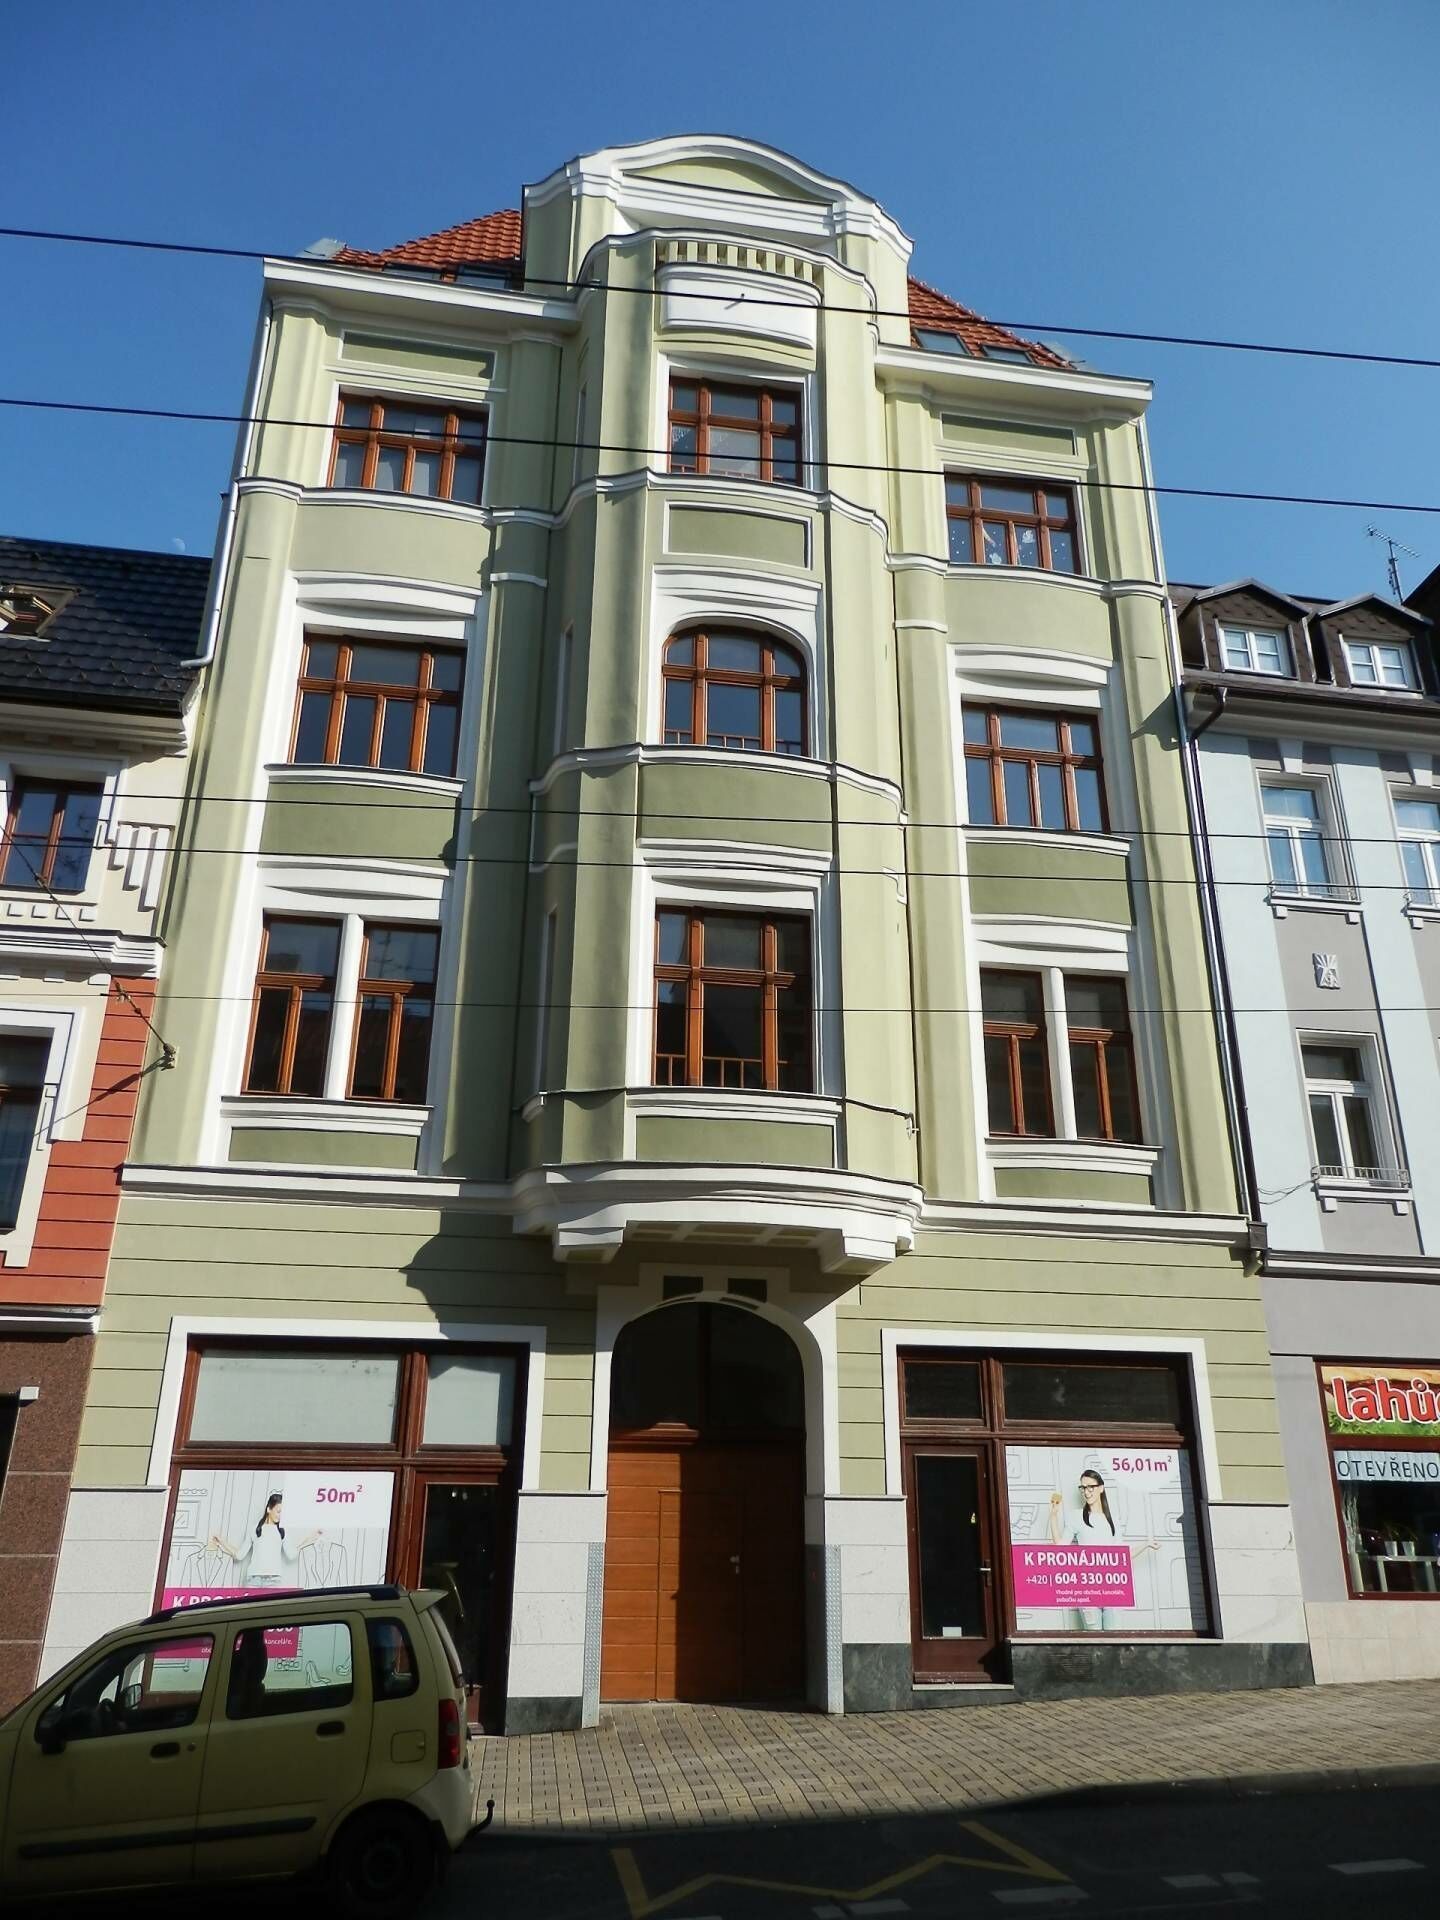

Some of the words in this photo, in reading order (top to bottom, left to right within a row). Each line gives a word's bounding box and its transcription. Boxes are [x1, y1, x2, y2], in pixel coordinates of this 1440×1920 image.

[1332, 1376, 1440, 1423] lahů
[1337, 1457, 1439, 1479] OTEVŘENO
[1024, 1552, 1035, 1566] K
[1037, 1549, 1119, 1566] PRONÁJMU
[1025, 1574, 1048, 1585] +420
[1055, 1572, 1077, 1584] 604
[1080, 1573, 1103, 1584] 330
[1105, 1573, 1128, 1584] 000
